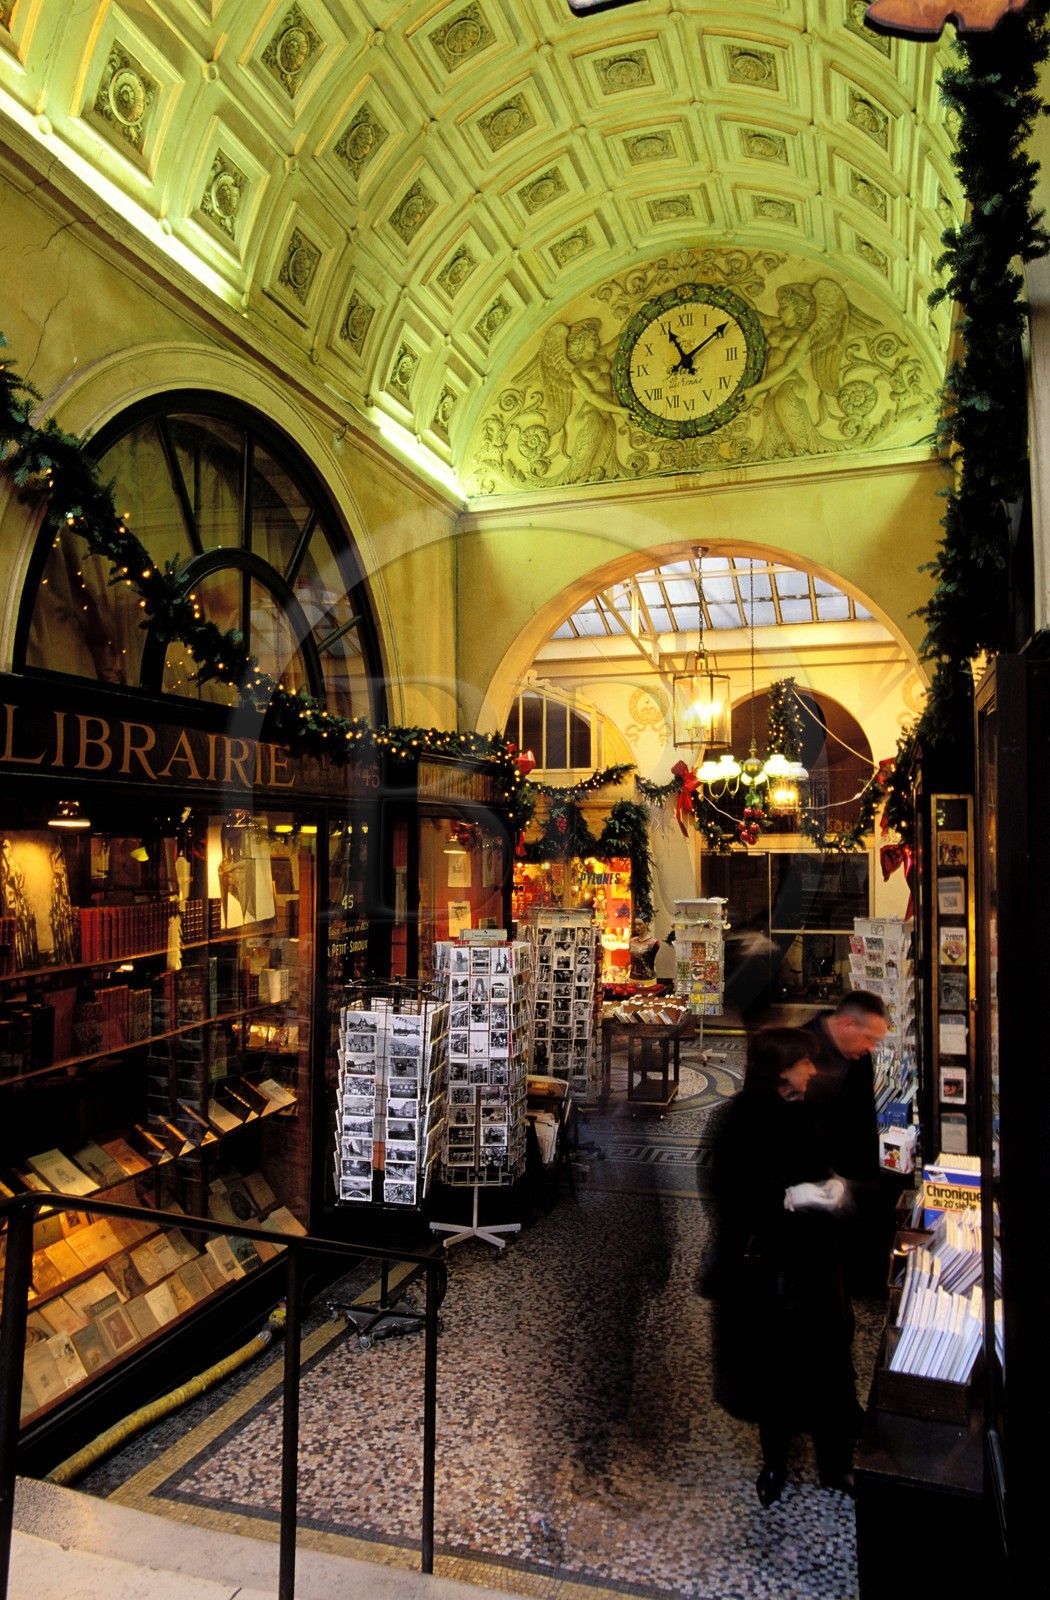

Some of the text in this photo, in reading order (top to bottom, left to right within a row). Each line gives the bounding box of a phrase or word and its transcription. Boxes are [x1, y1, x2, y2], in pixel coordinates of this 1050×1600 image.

[677, 313, 693, 327] XII
[644, 343, 654, 357] X
[725, 347, 738, 361] III
[636, 364, 649, 377] IX
[718, 376, 732, 390] IV
[644, 388, 663, 401] VIII
[702, 389, 713, 402] V
[666, 395, 680, 409] VII
[683, 399, 695, 411] VI
[0, 703, 296, 788] LIBRAIRIE
[361, 764, 381, 788] 45
[580, 872, 621, 885] PYLONES
[341, 894, 354, 910] 45
[926, 1185, 982, 1205] Chronique
[955, 1202, 977, 1212] sièle
